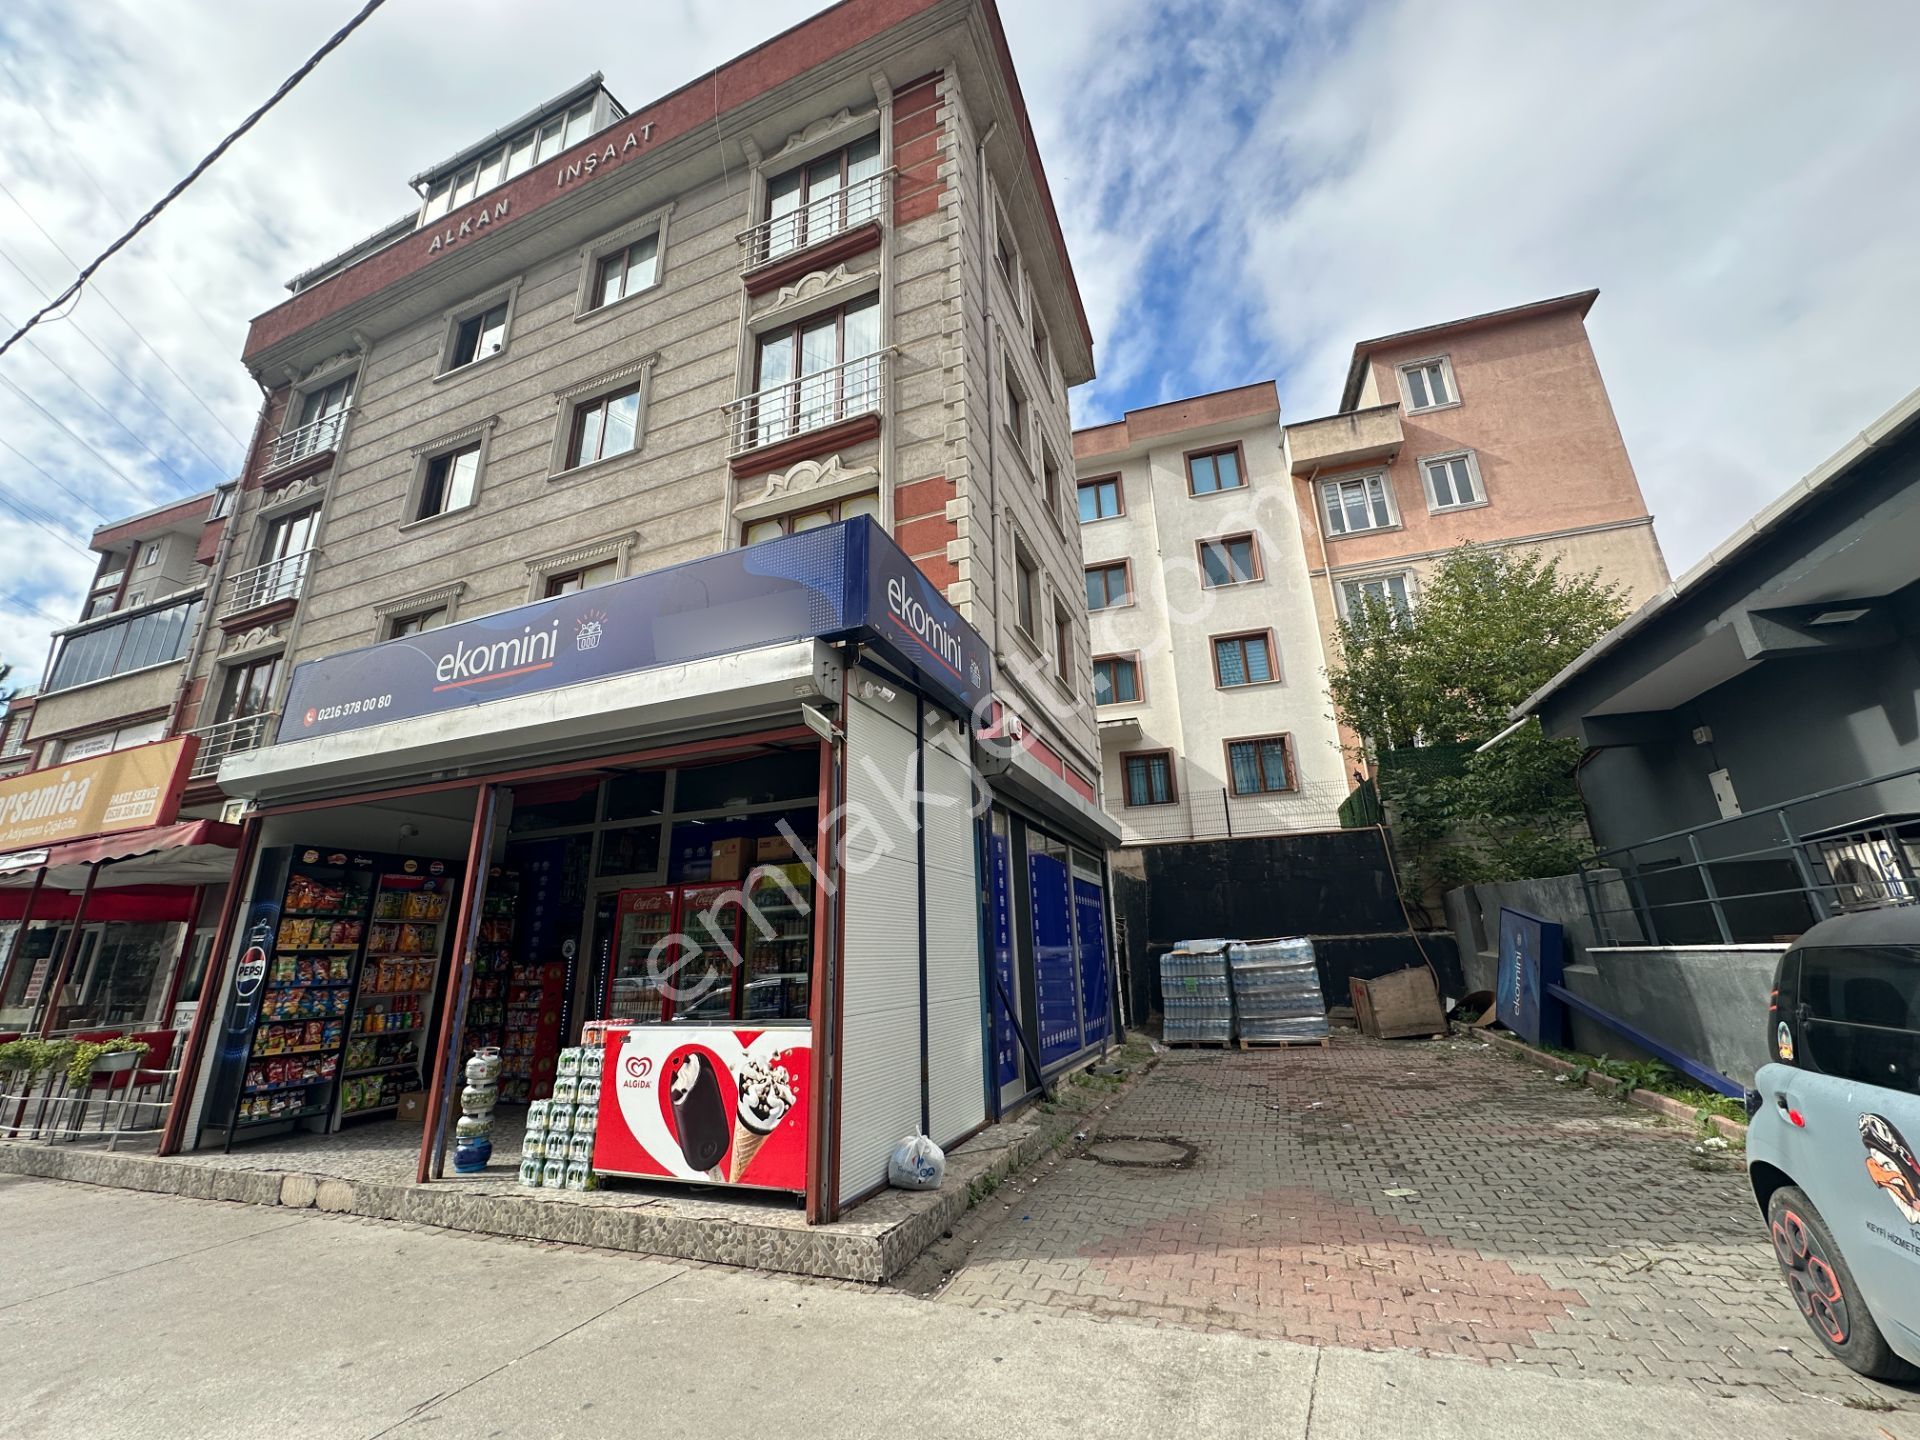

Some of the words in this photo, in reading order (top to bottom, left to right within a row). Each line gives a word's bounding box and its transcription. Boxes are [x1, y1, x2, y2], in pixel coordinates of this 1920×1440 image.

[428, 198, 510, 254] ALKAN
[435, 619, 560, 682] ekomini
[887, 576, 962, 672] ekomini
[317, 704, 342, 721] 0216
[342, 700, 361, 717] 378
[363, 698, 376, 713] 00
[377, 694, 392, 709] 80
[238, 965, 263, 977] PEPSI
[1513, 950, 1522, 1016] ekomini
